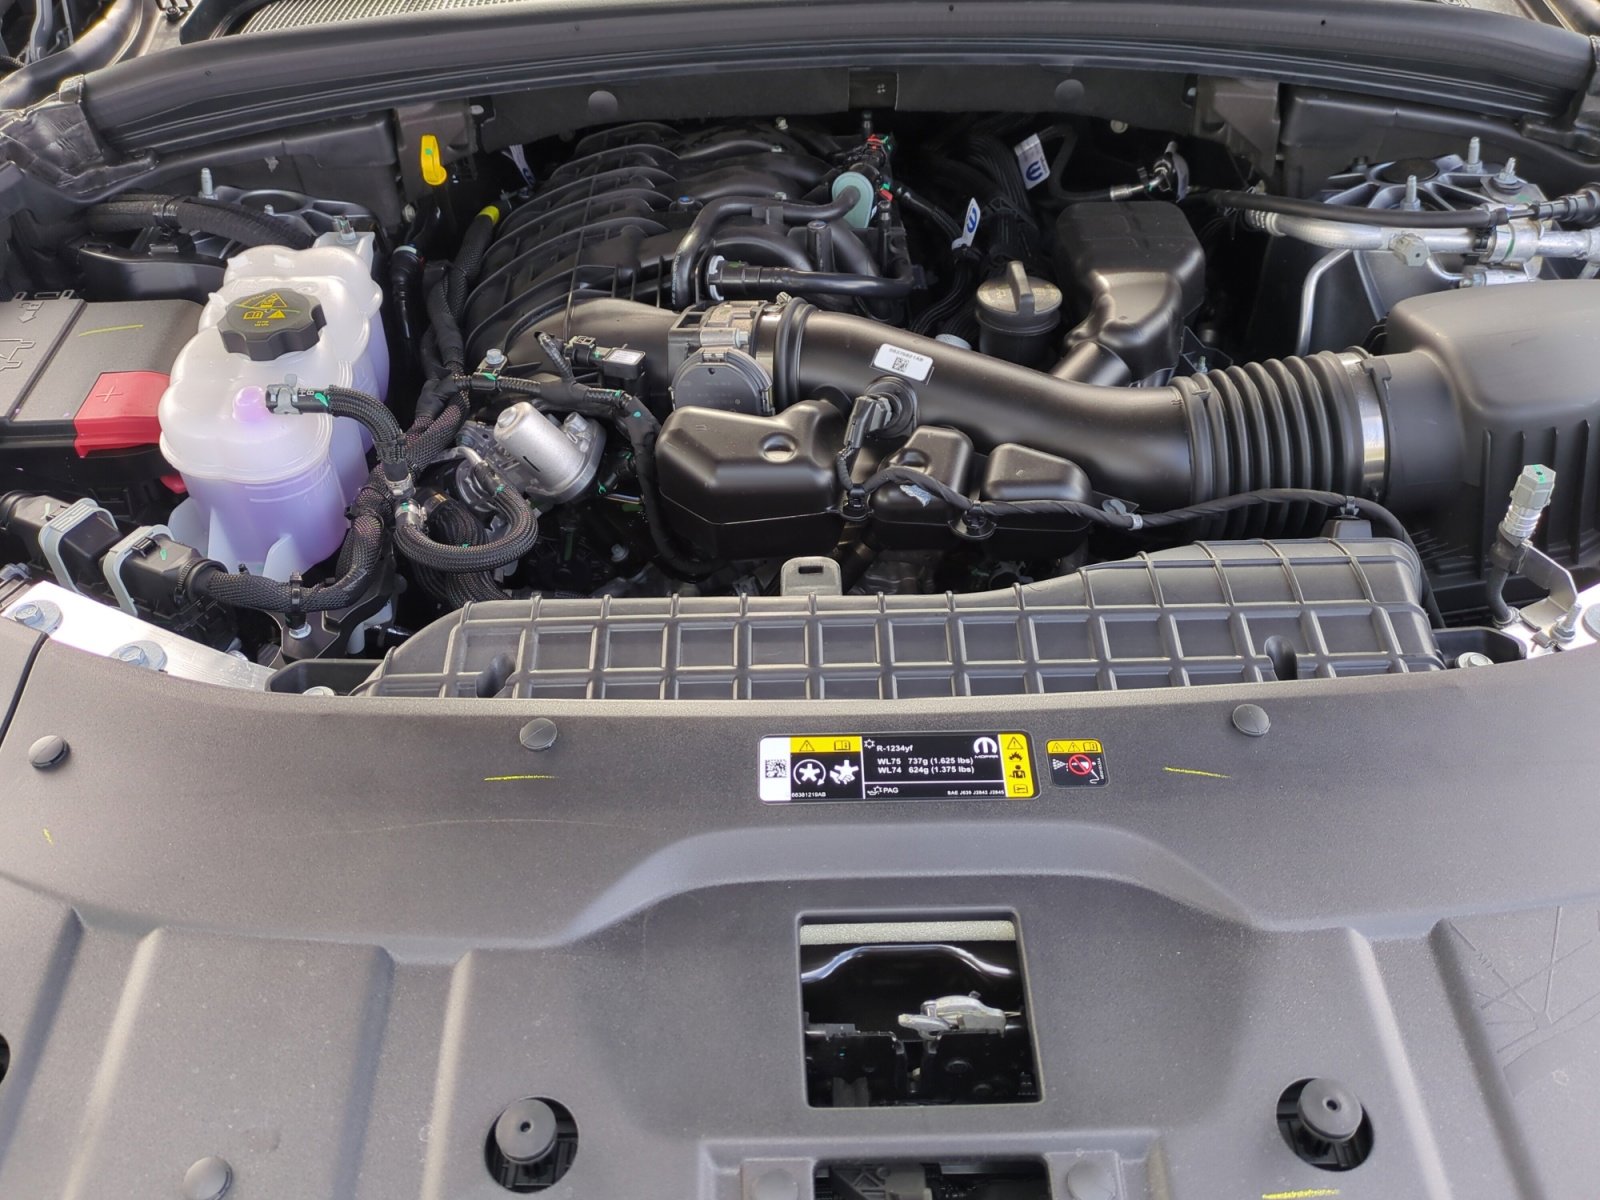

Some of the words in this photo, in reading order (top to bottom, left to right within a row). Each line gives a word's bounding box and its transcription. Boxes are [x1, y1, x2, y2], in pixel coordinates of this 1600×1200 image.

[876, 745, 913, 753] R-1234yf
[930, 757, 955, 765] (1.625
[931, 766, 957, 774] (1.375
[958, 766, 974, 774] lbs)
